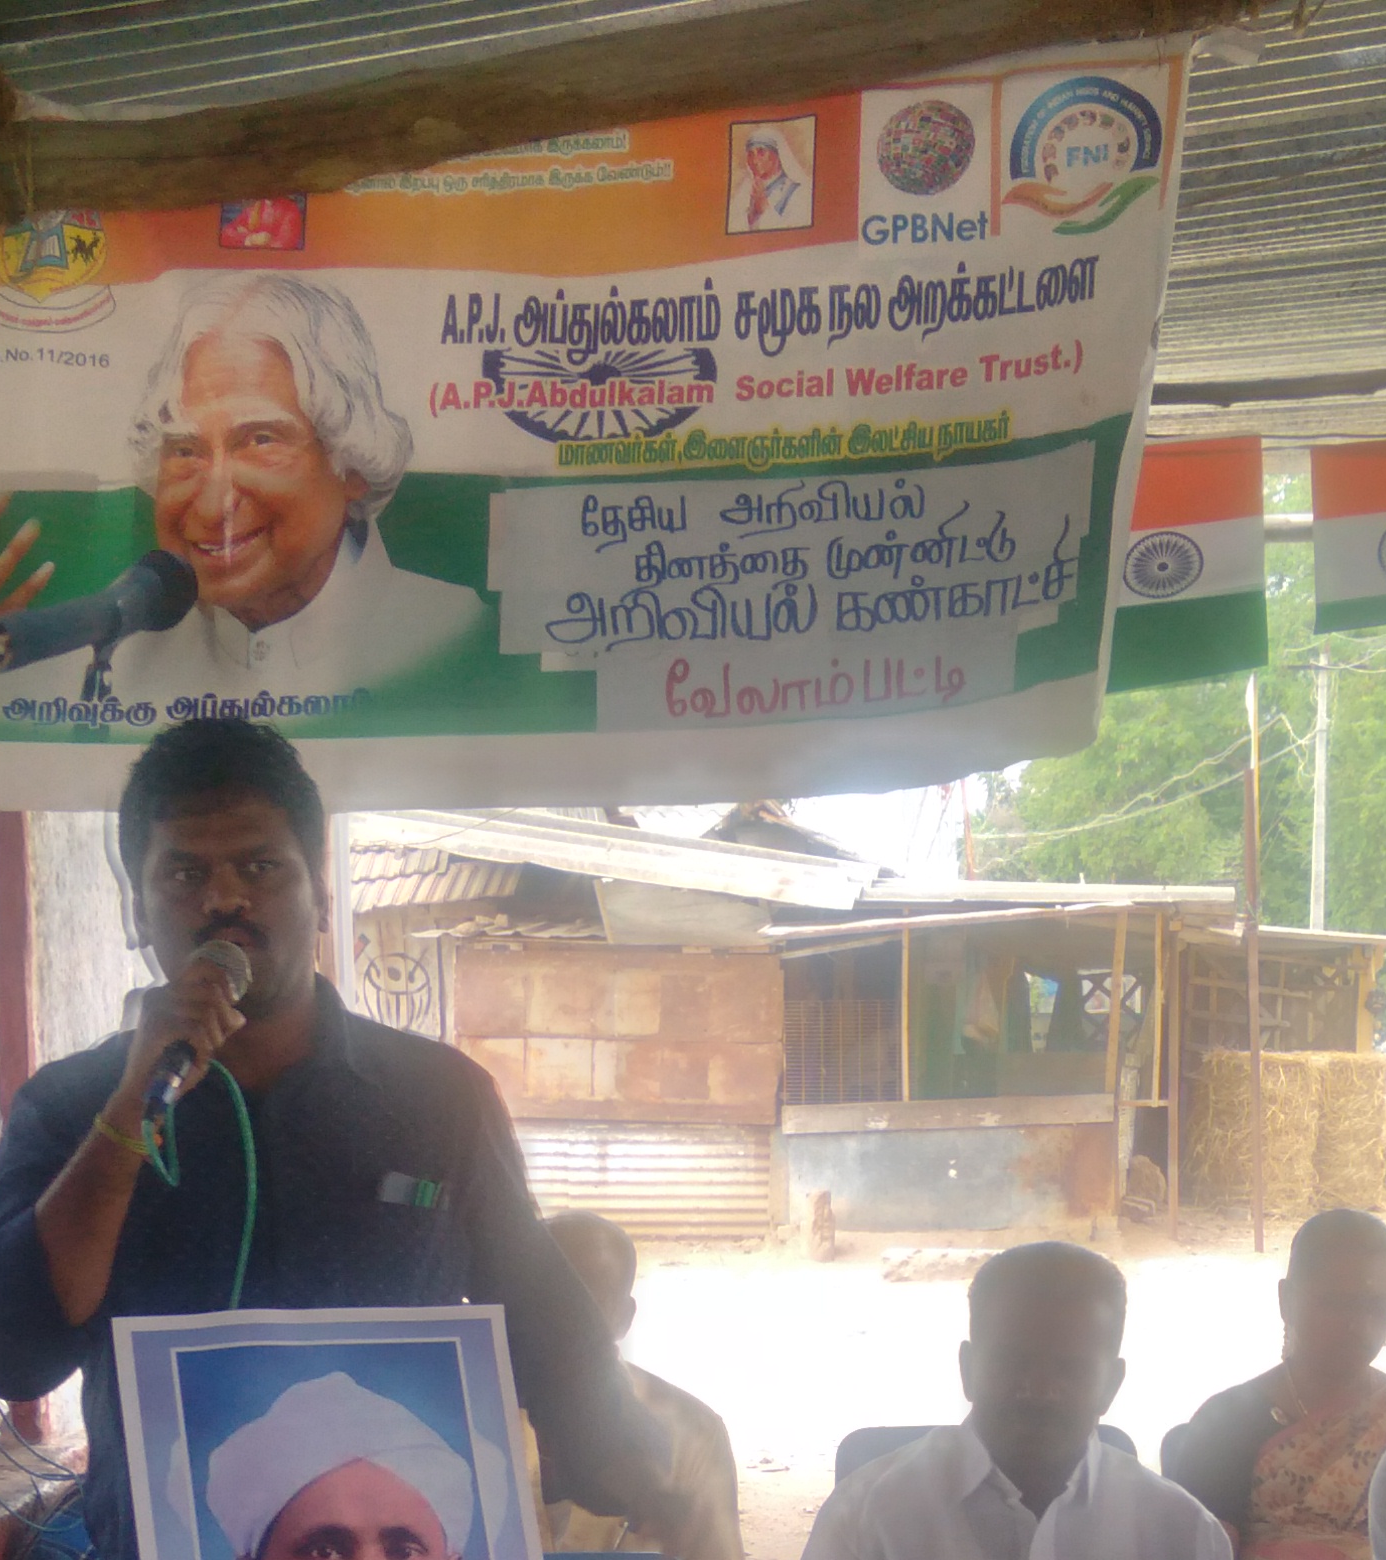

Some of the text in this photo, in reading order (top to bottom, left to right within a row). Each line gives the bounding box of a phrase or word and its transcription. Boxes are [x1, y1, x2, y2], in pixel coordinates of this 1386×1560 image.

[1065, 144, 1110, 168] FNI
[861, 210, 989, 246] GPBNet
[441, 253, 1101, 363] A.P.J. அப்துல்கலாம் சமூக நல அறக்கட்டளை
[735, 368, 834, 402] Social
[845, 362, 969, 398] Welfare
[979, 339, 1084, 385] Trust.)
[581, 478, 926, 552] தேசிய அறிவியல்
[634, 540, 809, 589] தினத்தை
[545, 583, 819, 651] அறிவியல்
[2, 695, 158, 727] அறிவுக்கு
